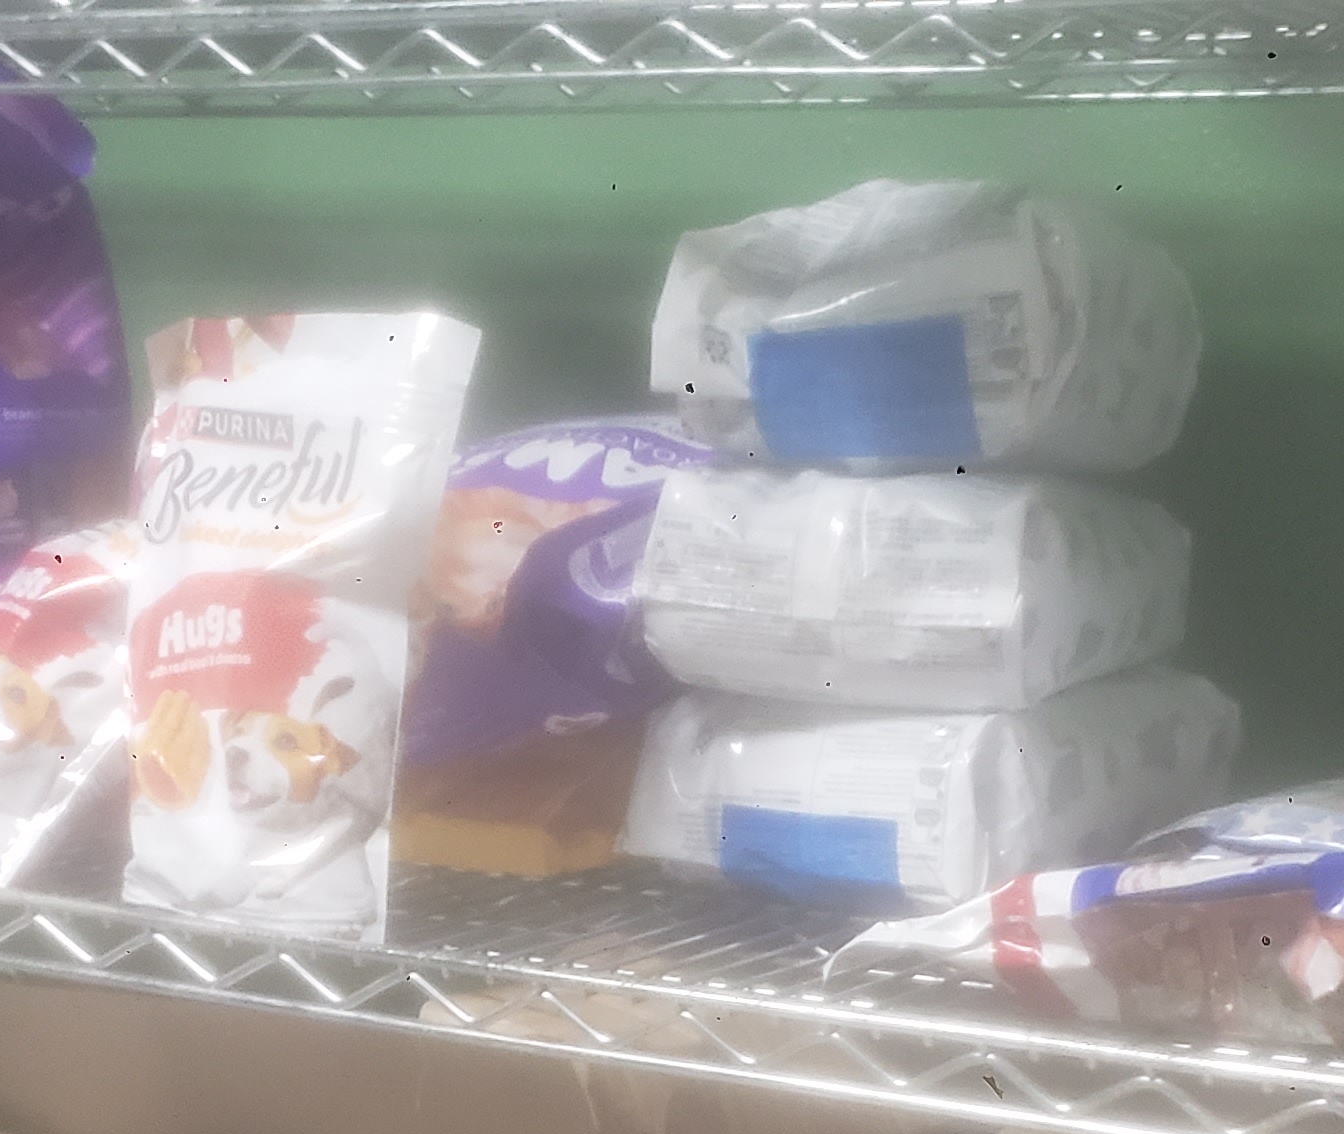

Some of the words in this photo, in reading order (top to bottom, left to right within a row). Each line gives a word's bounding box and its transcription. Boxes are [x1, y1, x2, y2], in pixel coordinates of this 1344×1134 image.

[197, 412, 291, 443] PURINA
[143, 418, 361, 543] Beneful
[158, 604, 243, 659] Hugs
